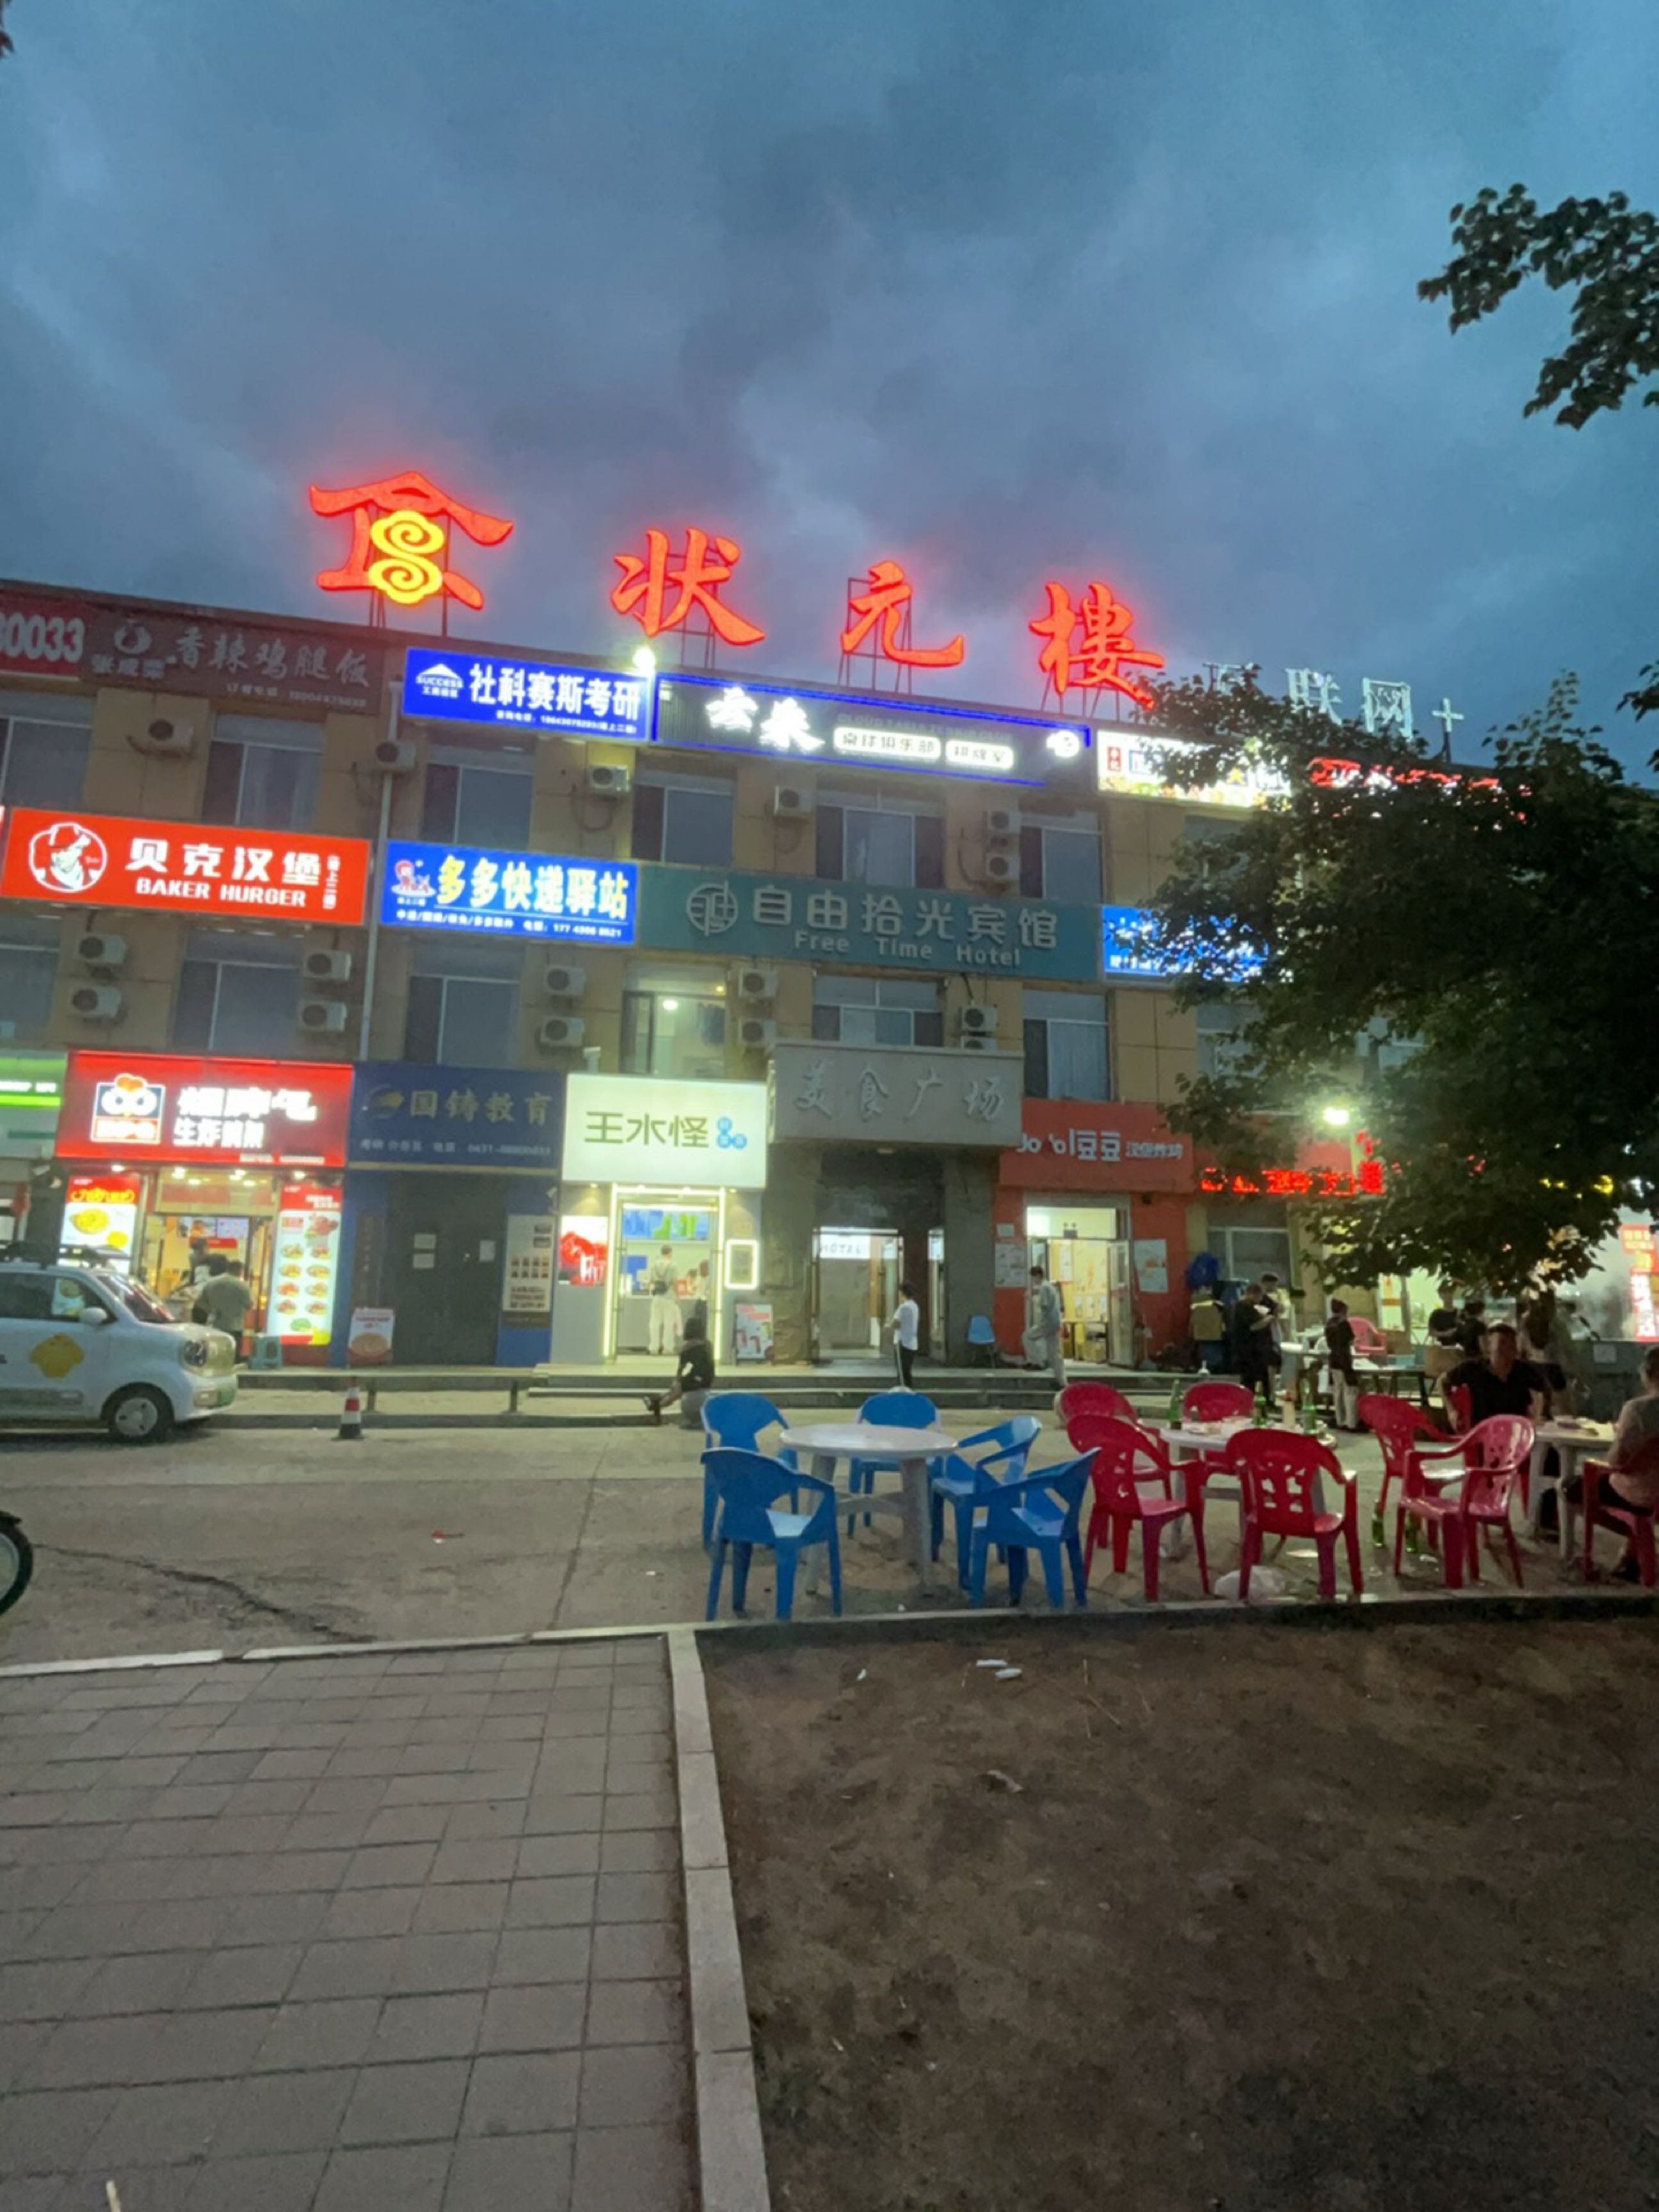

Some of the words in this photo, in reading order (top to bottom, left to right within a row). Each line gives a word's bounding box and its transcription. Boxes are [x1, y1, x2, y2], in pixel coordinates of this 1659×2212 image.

[0, 612, 84, 664] 0033
[176, 626, 369, 688] 香辣鸡腿饭
[469, 663, 639, 721] 社科赛斯考研
[125, 837, 321, 886] 贝克汉堡
[136, 878, 210, 900] BAKER
[220, 884, 307, 908] HURGER
[752, 885, 1058, 949] 自由拾光宾馆
[794, 929, 851, 954] Free
[875, 937, 933, 961] Time
[956, 944, 1021, 968] Hotel
[793, 1059, 1004, 1123] 美食广场
[584, 1111, 710, 1148] 王水怪
